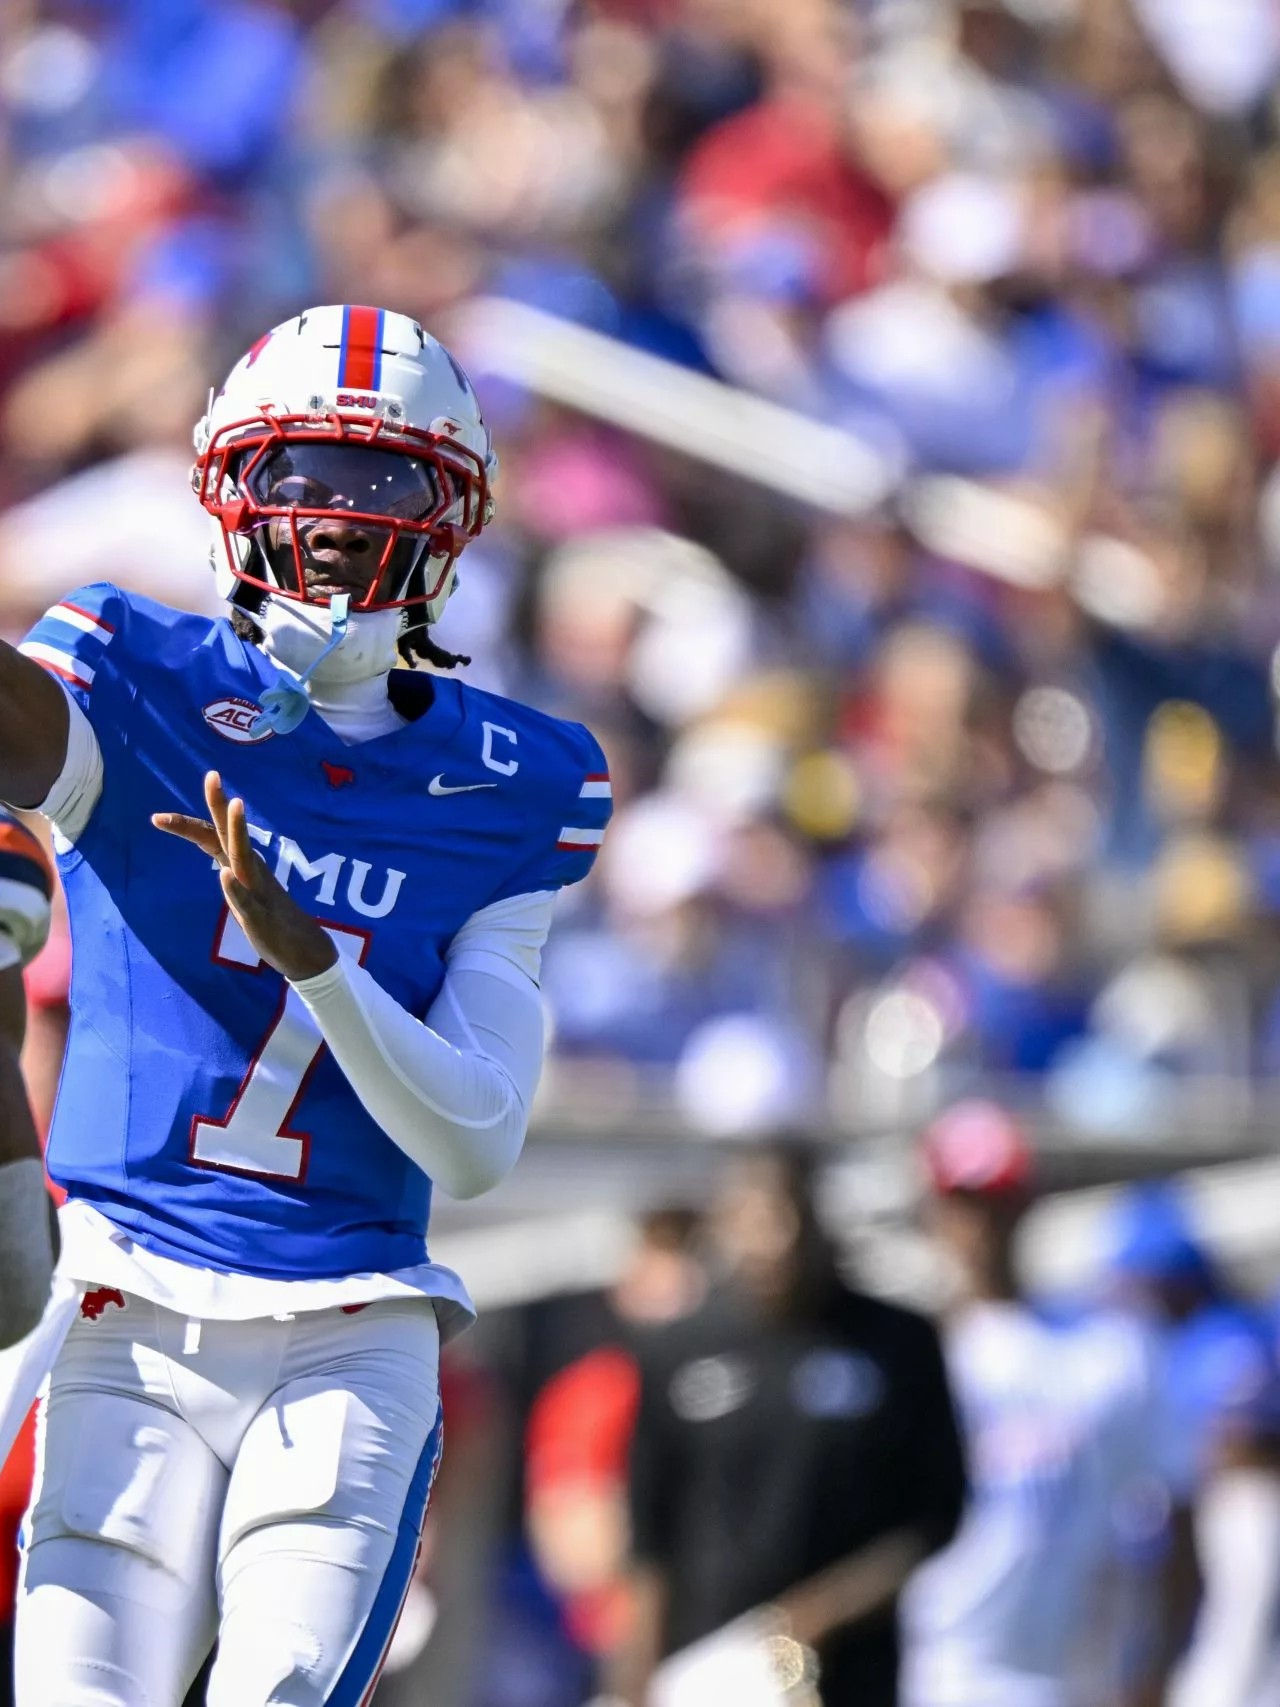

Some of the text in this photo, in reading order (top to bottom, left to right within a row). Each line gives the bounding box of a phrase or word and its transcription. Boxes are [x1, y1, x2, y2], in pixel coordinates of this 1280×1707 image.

[336, 394, 377, 409] SMU
[482, 721, 519, 776] C
[211, 822, 407, 919] MU
[188, 900, 372, 1185] 7
